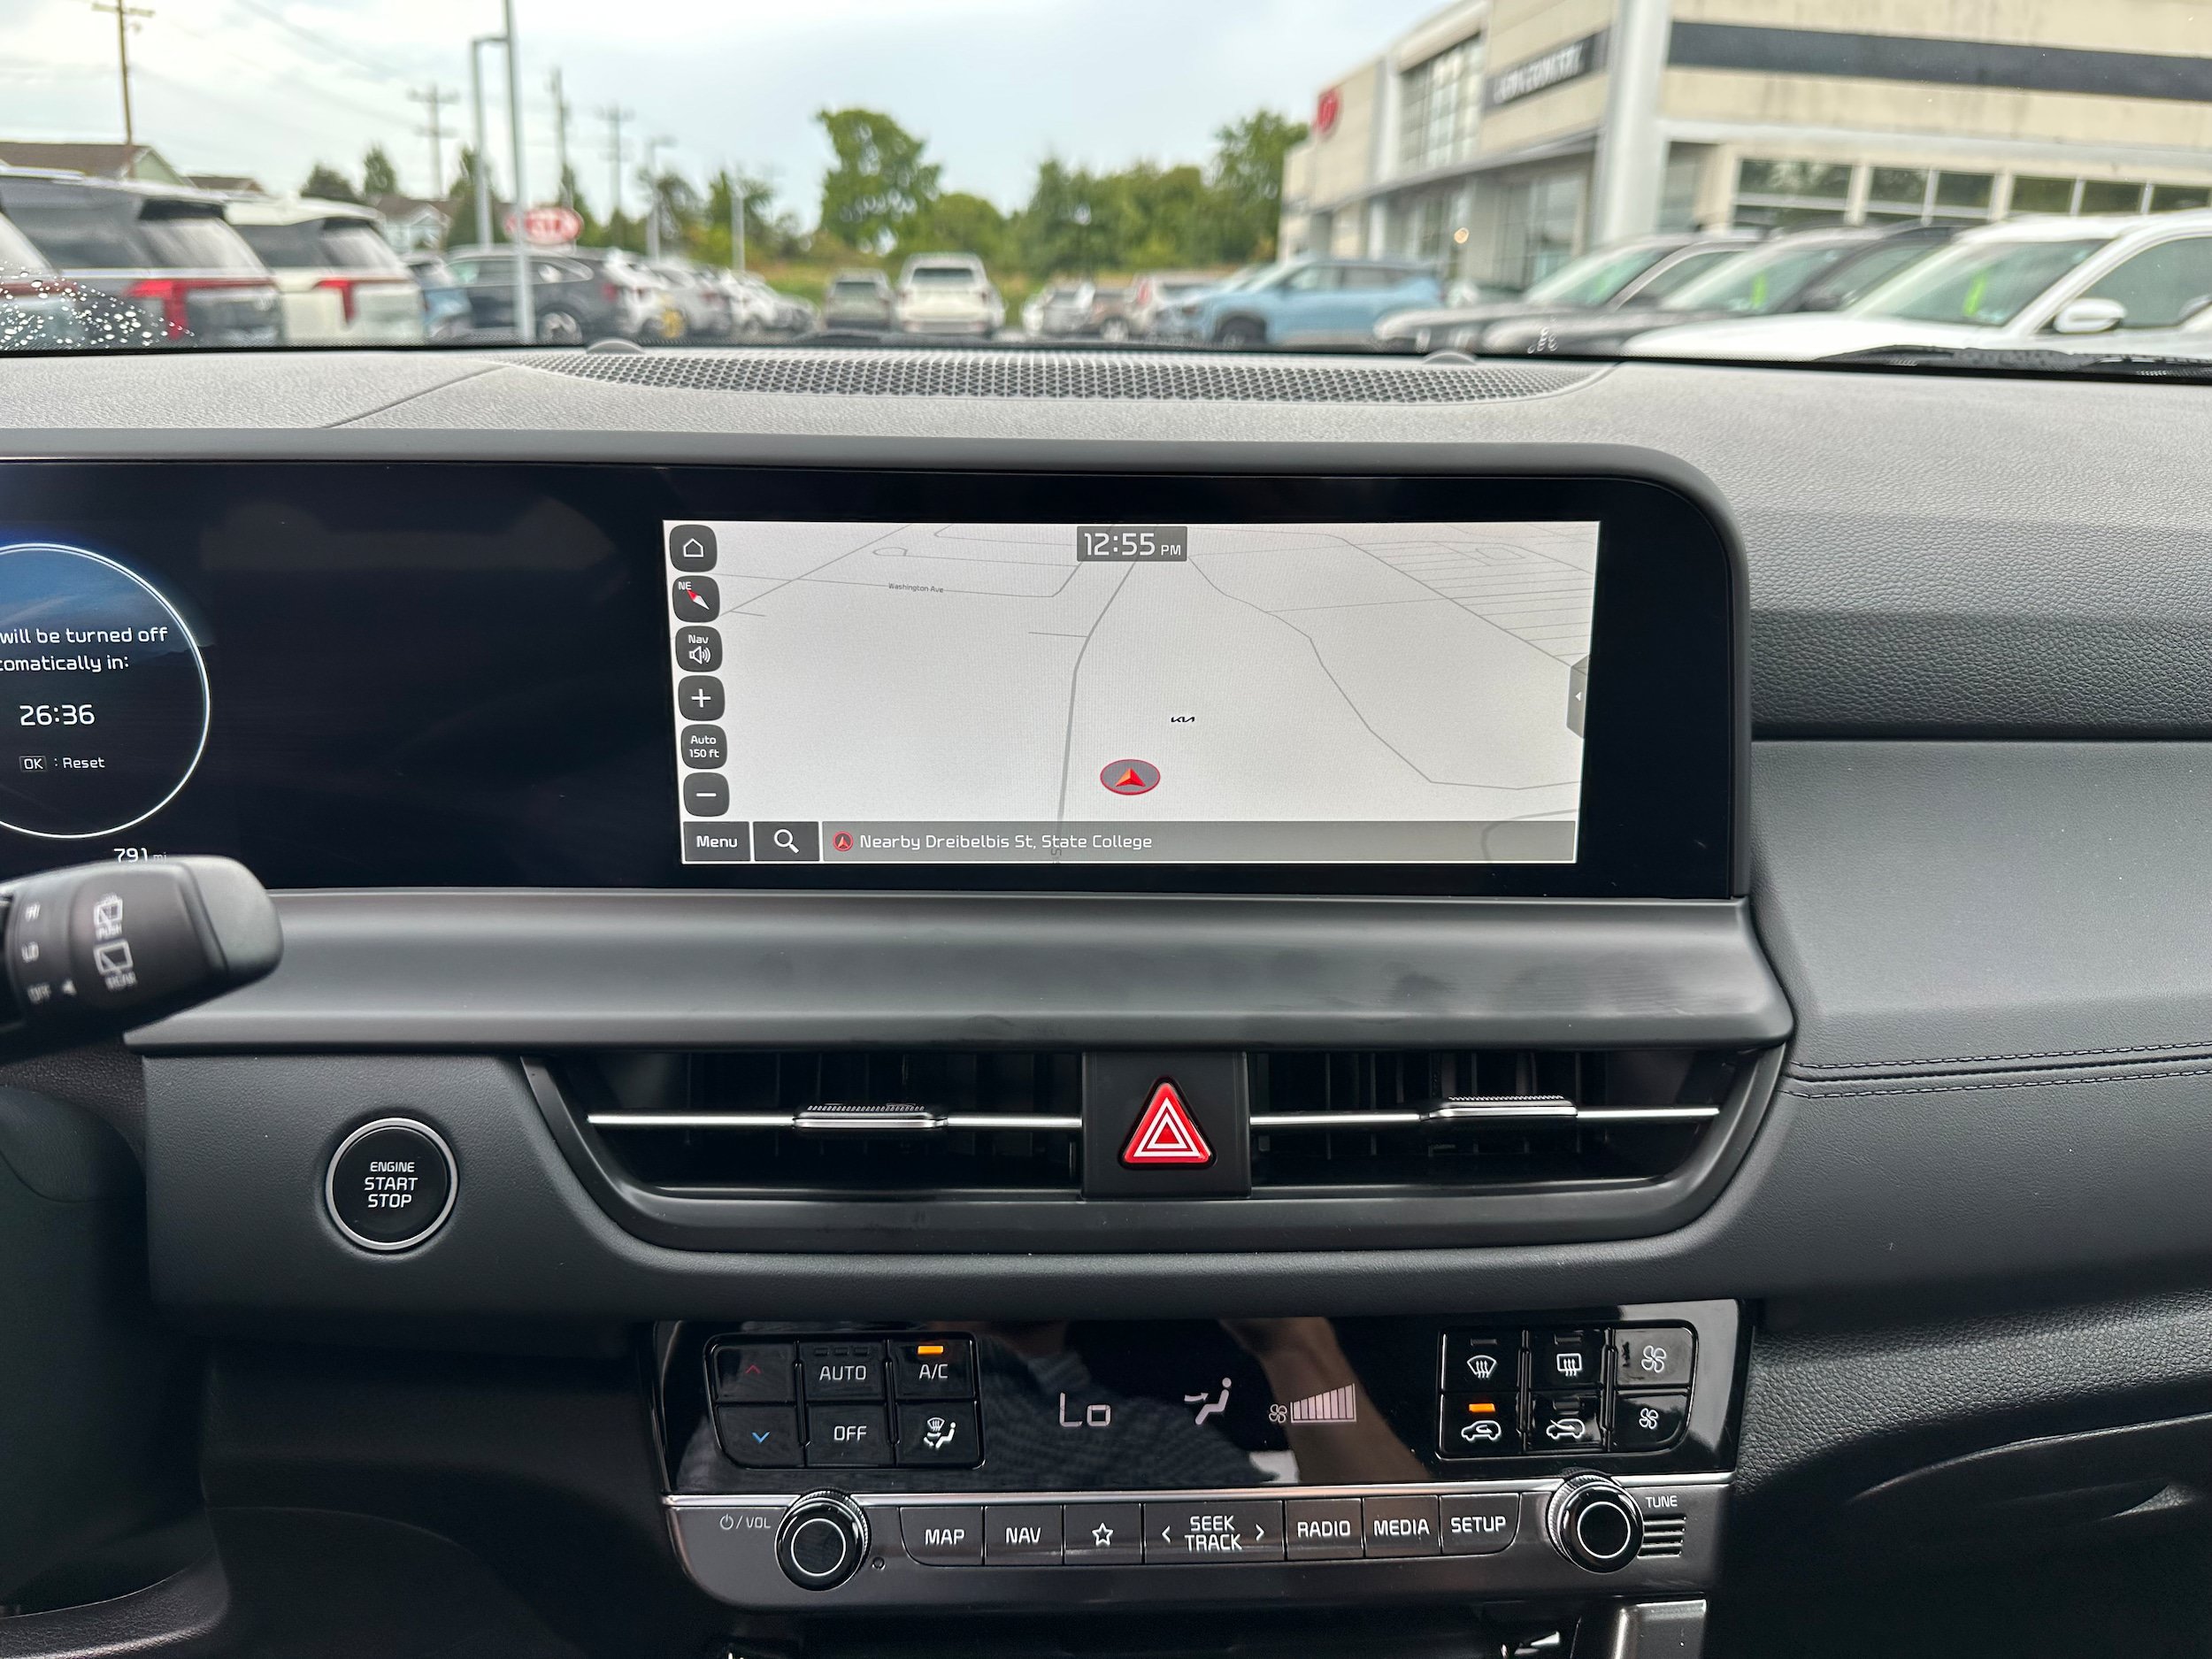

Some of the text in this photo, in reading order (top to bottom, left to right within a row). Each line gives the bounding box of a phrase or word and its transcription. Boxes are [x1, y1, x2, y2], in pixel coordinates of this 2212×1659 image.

[1084, 533, 1181, 556] 12:55 PM
[678, 580, 692, 591] NE
[888, 583, 929, 592] Washington
[0, 626, 168, 644] will be turned off
[687, 634, 709, 644] Nav
[106, 654, 129, 670] in:
[19, 703, 96, 726] 26:36
[690, 734, 717, 745] Auto
[688, 749, 720, 758] 150 ft
[24, 757, 43, 770] OK
[62, 757, 105, 769] Reset
[696, 835, 738, 849] Menu
[860, 834, 1152, 850] Nearby Dreibelbis St, State College
[112, 847, 168, 864] 791 mi
[370, 1161, 415, 1173] ENGINE
[364, 1176, 419, 1191] START
[367, 1193, 412, 1209] STOP
[819, 1365, 866, 1381] AUTO
[918, 1363, 949, 1379] A/C
[833, 1425, 867, 1441] OFF
[1646, 1494, 1678, 1509] TUNE
[1189, 1515, 1235, 1532] SEEK
[1297, 1520, 1351, 1538] RADIO
[1373, 1518, 1430, 1536] MEDIA
[1450, 1516, 1506, 1533] SETUP
[925, 1528, 965, 1546] MAP
[1005, 1527, 1041, 1544] NAV
[1184, 1533, 1243, 1552] TRACK
